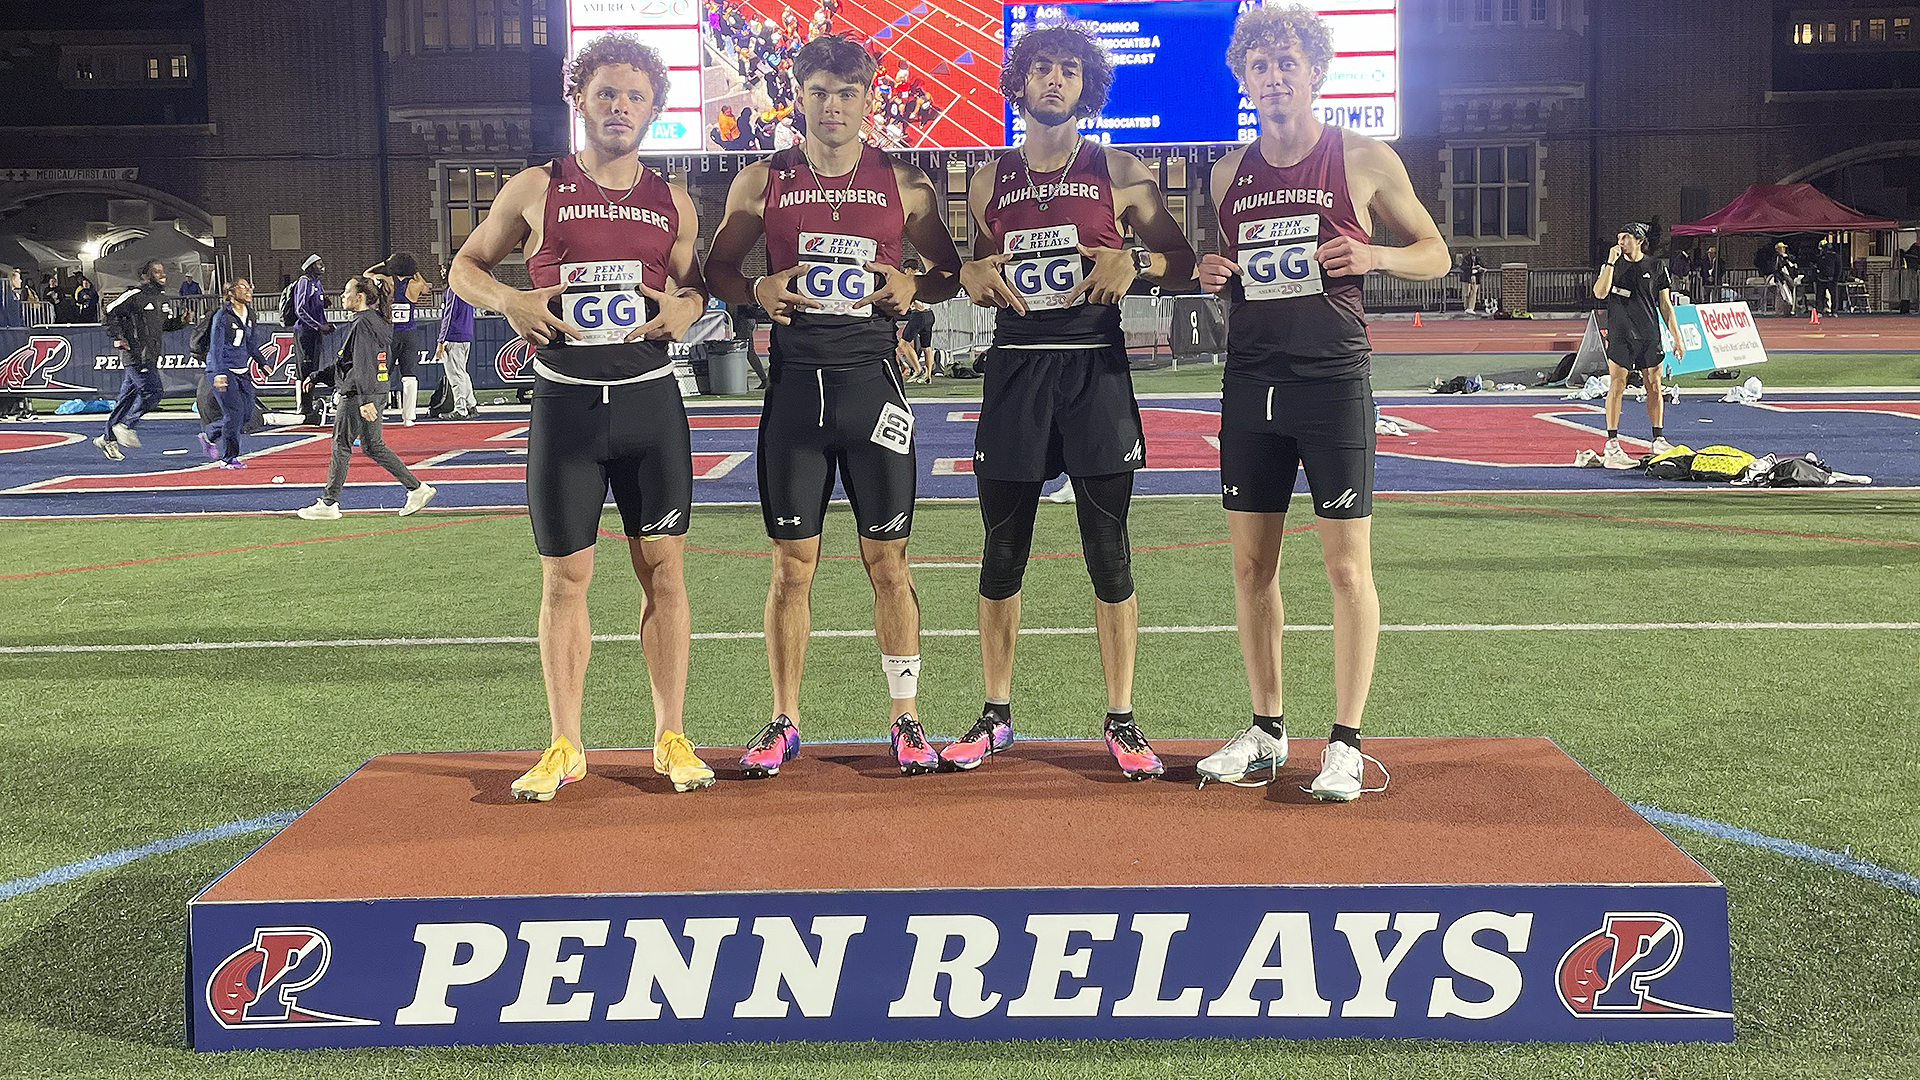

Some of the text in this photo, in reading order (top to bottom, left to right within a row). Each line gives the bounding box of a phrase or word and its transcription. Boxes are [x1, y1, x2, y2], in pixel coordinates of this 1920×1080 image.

[1011, 6, 1027, 19] 19
[1151, 35, 1161, 48] A
[1152, 115, 1161, 128] B
[1238, 113, 1256, 125] BA
[1324, 106, 1385, 128] POWER
[654, 123, 679, 138] AVE
[1238, 128, 1257, 141] BB
[1012, 133, 1027, 147] 27
[36, 169, 116, 180] MEDICAL/FIRST AID
[779, 189, 888, 208] MUHLENBERG
[997, 183, 1100, 210] MUHLENBERG
[1232, 189, 1334, 215] MUHLENBERG
[557, 204, 669, 233] MUHLENBERG
[1271, 219, 1302, 230] PENN
[1030, 229, 1060, 241] PENN
[1269, 226, 1311, 238] RELAYS
[830, 238, 861, 248] PENN
[1029, 236, 1070, 249] RELAYS
[594, 264, 625, 274] PENN
[1247, 246, 1310, 283] GG
[593, 272, 634, 282] RELAYS
[805, 265, 865, 300] GG
[1013, 258, 1075, 295] GG
[393, 311, 406, 319] CL
[573, 293, 637, 329] GG
[1699, 307, 1751, 334] Rekortan
[882, 412, 909, 445] GG
[397, 915, 867, 1026] PENN
[886, 911, 1534, 1021] RELAYS
